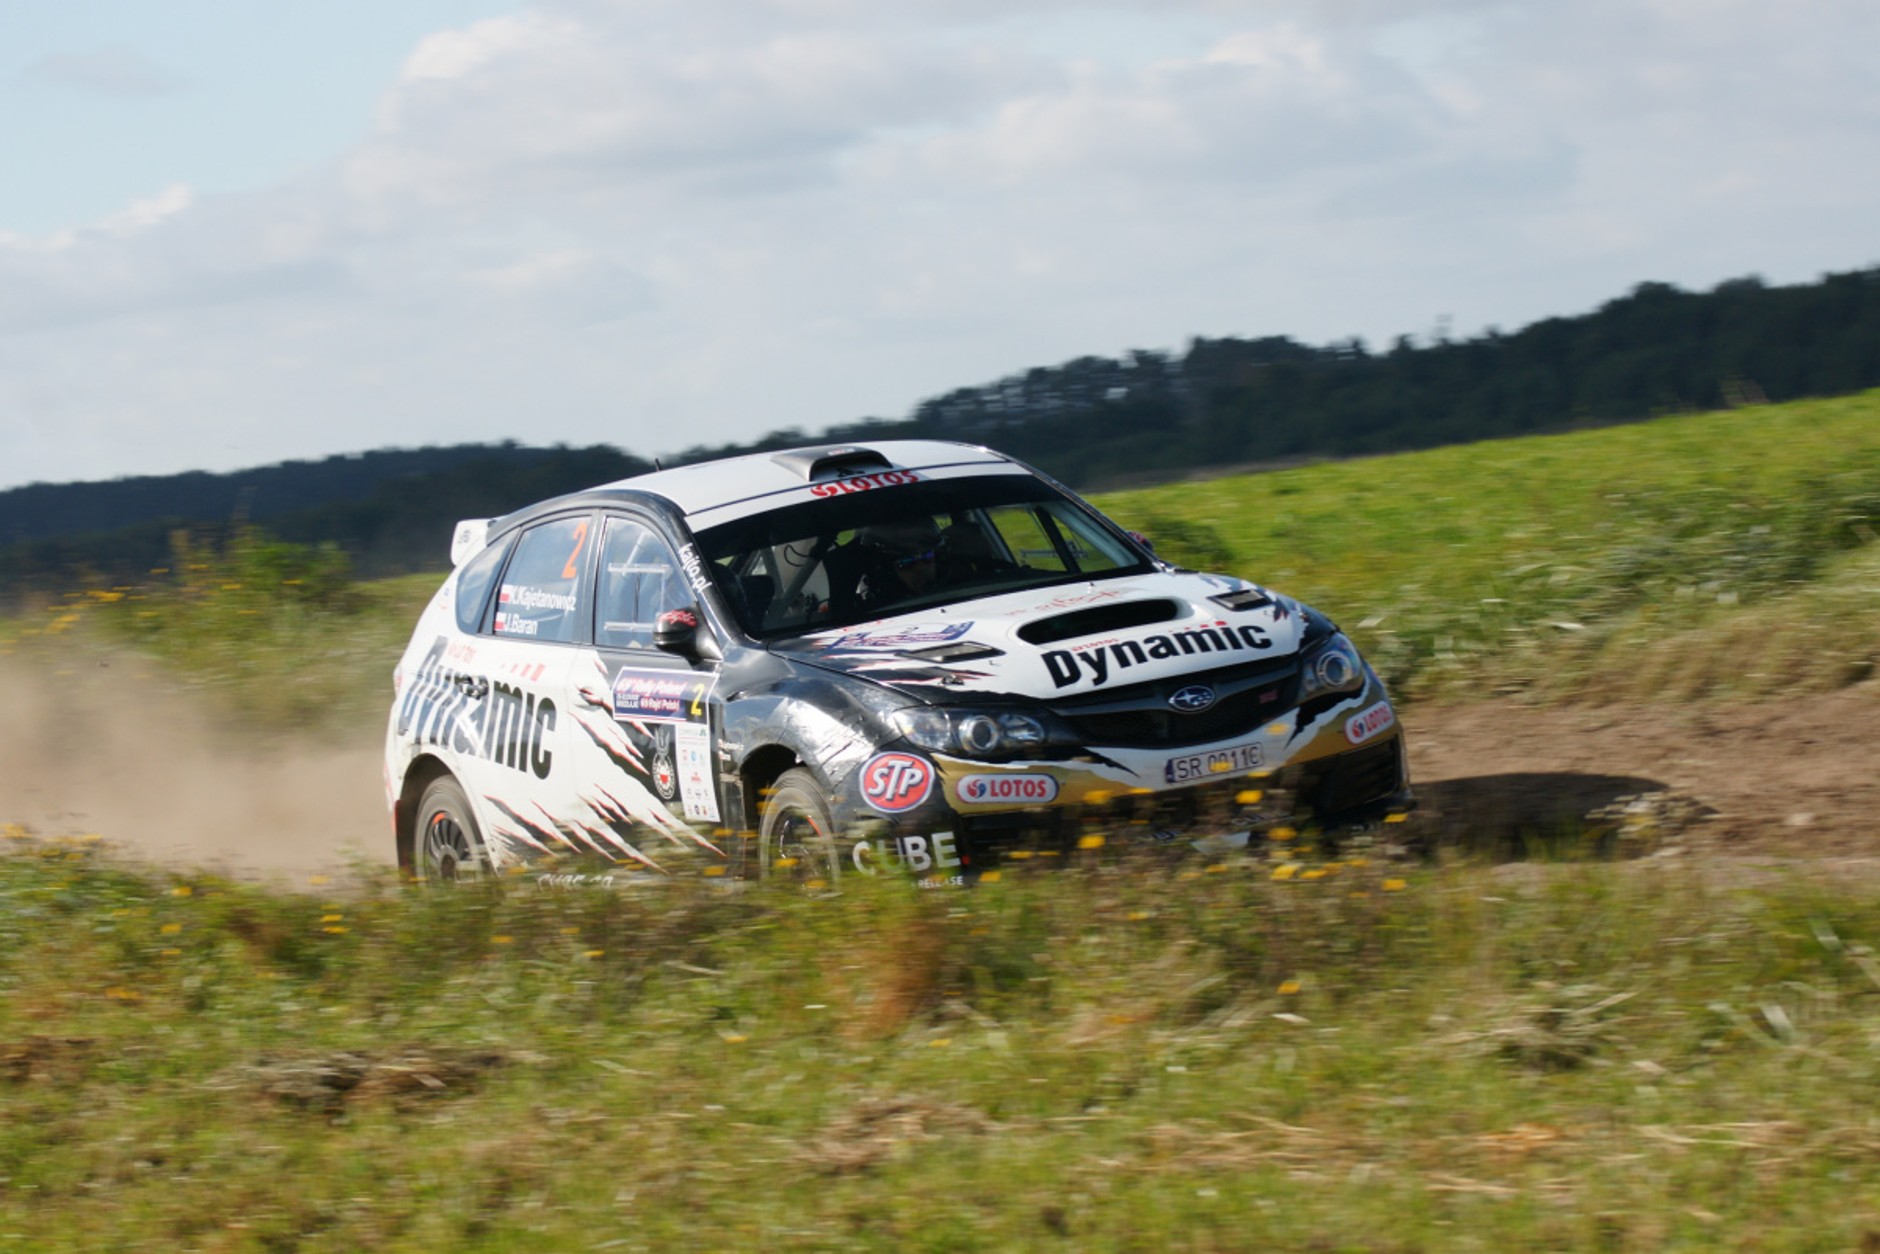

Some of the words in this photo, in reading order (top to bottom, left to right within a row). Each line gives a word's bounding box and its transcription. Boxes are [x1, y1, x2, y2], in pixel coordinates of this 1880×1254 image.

[836, 469, 919, 494] LOTOS
[561, 521, 588, 578] 2
[1041, 624, 1272, 689] Dynamic
[690, 684, 705, 716] 2
[868, 760, 924, 801] STP
[1176, 757, 1202, 779] SR
[990, 779, 1047, 798] LOTOS
